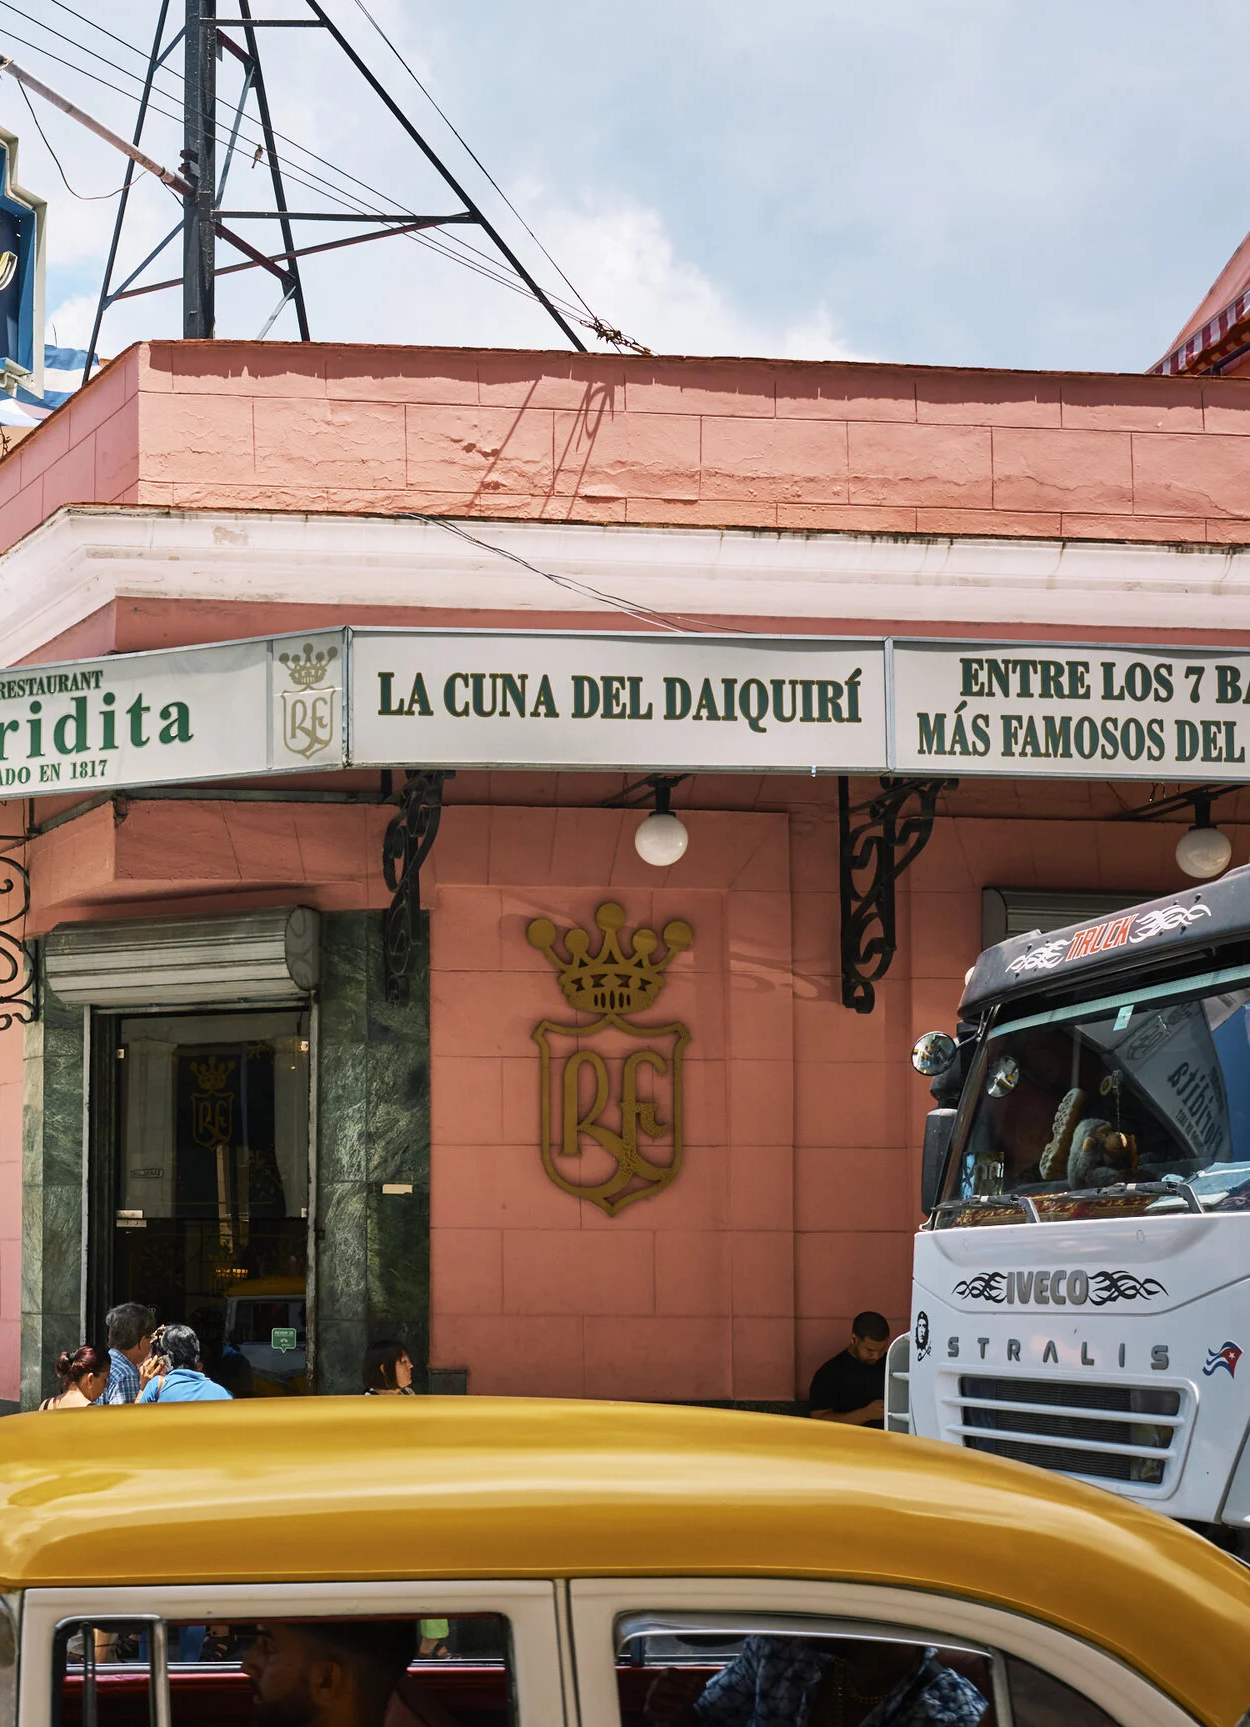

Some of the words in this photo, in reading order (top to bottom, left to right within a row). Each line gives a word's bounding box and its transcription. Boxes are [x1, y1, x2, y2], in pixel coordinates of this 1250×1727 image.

[377, 670, 434, 716] LA
[443, 671, 559, 719] CUNA
[570, 674, 653, 720] DEL
[662, 668, 863, 733] DAIQUIRÍ
[959, 657, 1091, 700] ENTRE
[1100, 661, 1174, 702] LOS
[1183, 665, 1206, 703] 7
[1215, 664, 1250, 705] B
[916, 700, 990, 757] MÁS
[1000, 714, 1165, 762] FAMOSOS
[1174, 719, 1246, 763] DEL
[39, 763, 61, 783] EN
[70, 759, 108, 780] 1817
[1065, 912, 1140, 962] TRUCK
[1006, 1269, 1089, 1306] IVECO
[947, 1336, 1169, 1371] STRALIS
